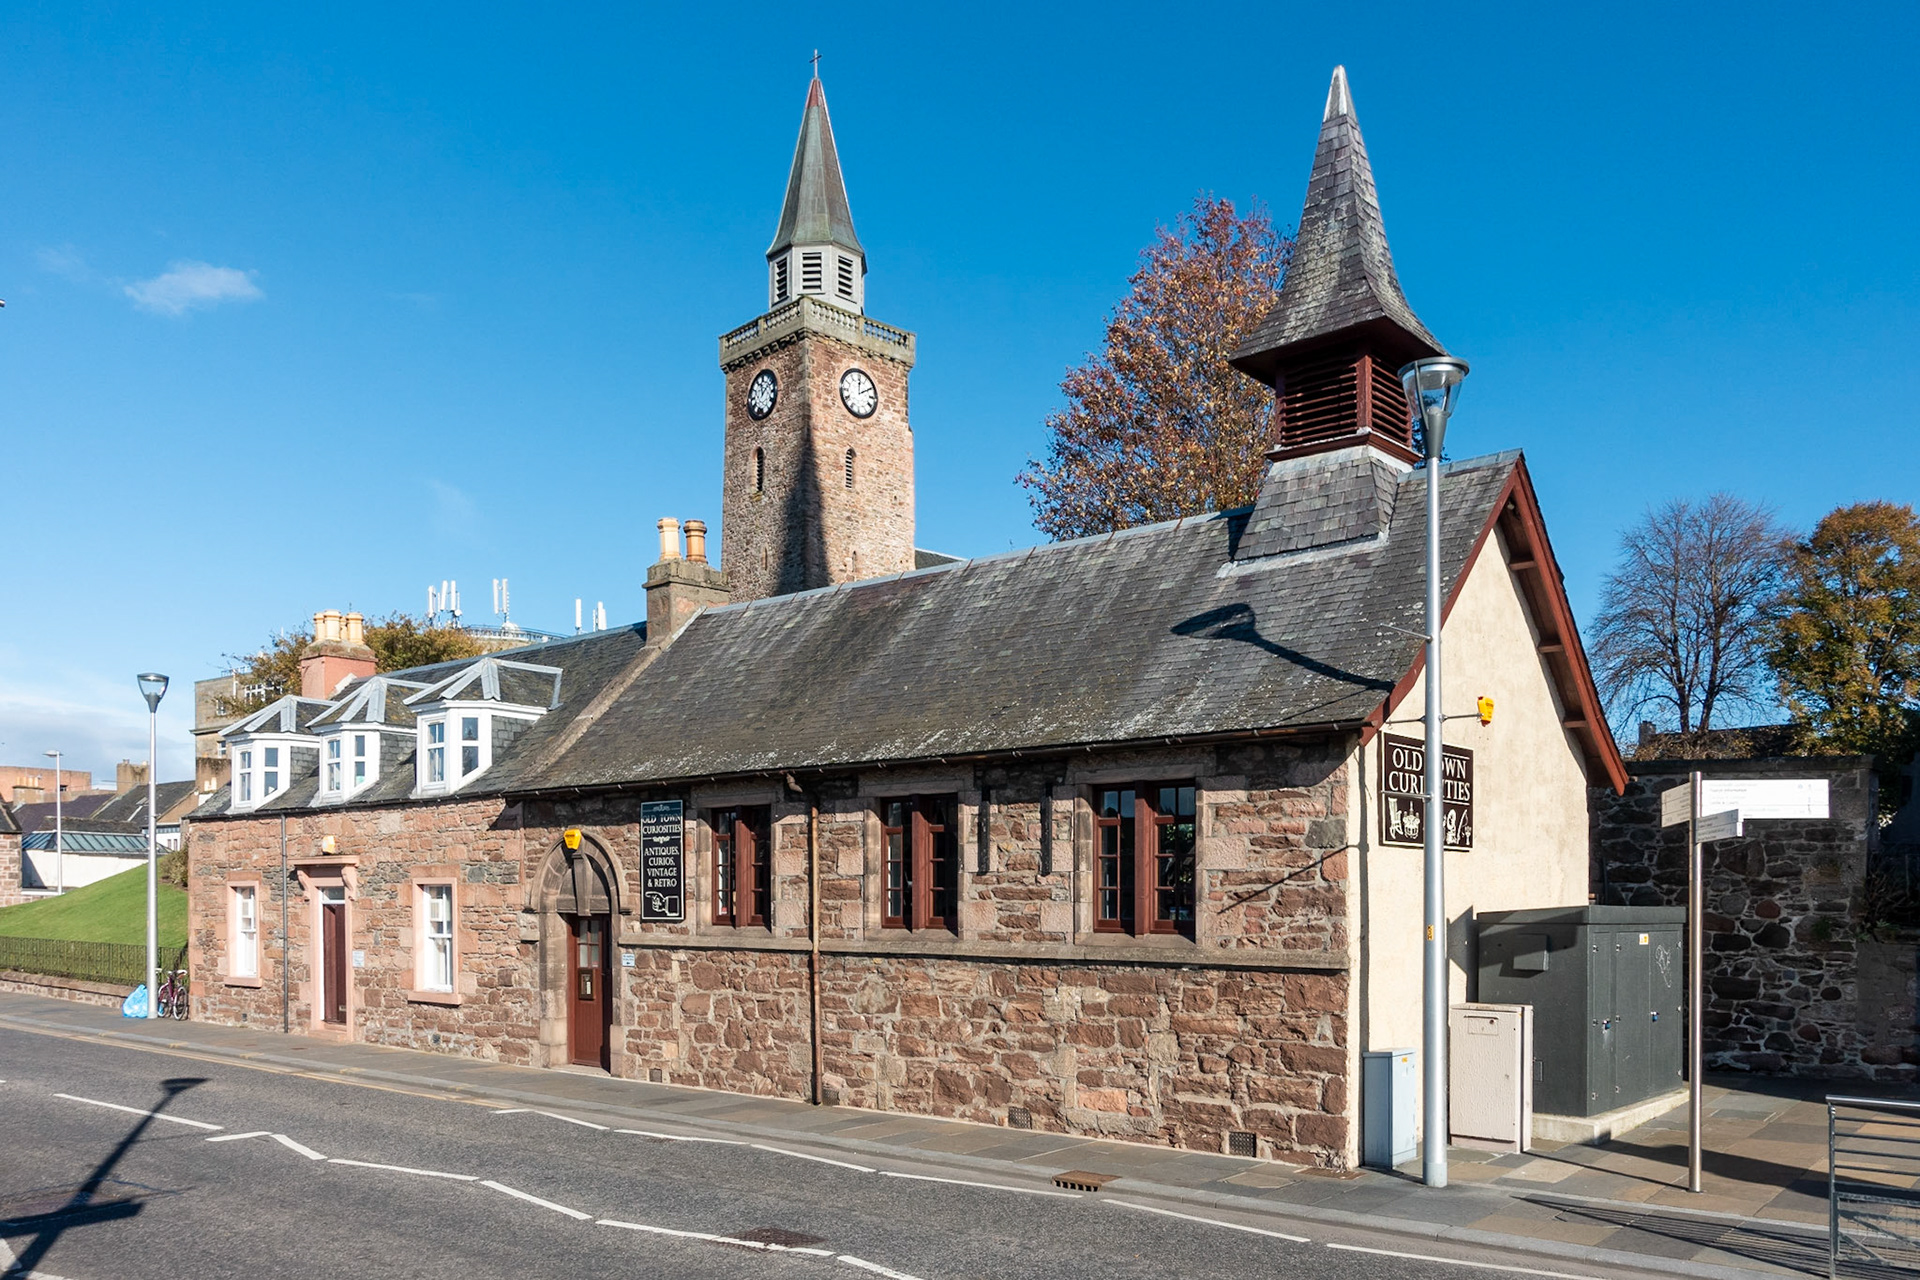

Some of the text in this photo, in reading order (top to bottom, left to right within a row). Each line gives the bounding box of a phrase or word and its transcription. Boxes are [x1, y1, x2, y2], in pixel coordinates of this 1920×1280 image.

[1392, 748, 1467, 779] OLD WN
[1388, 771, 1471, 801] CURITIES
[642, 814, 681, 824] OLD TOWN
[642, 824, 681, 834] CURIOSITIES
[647, 867, 677, 877] VINTAGE
[647, 878, 677, 887] & RETRO
